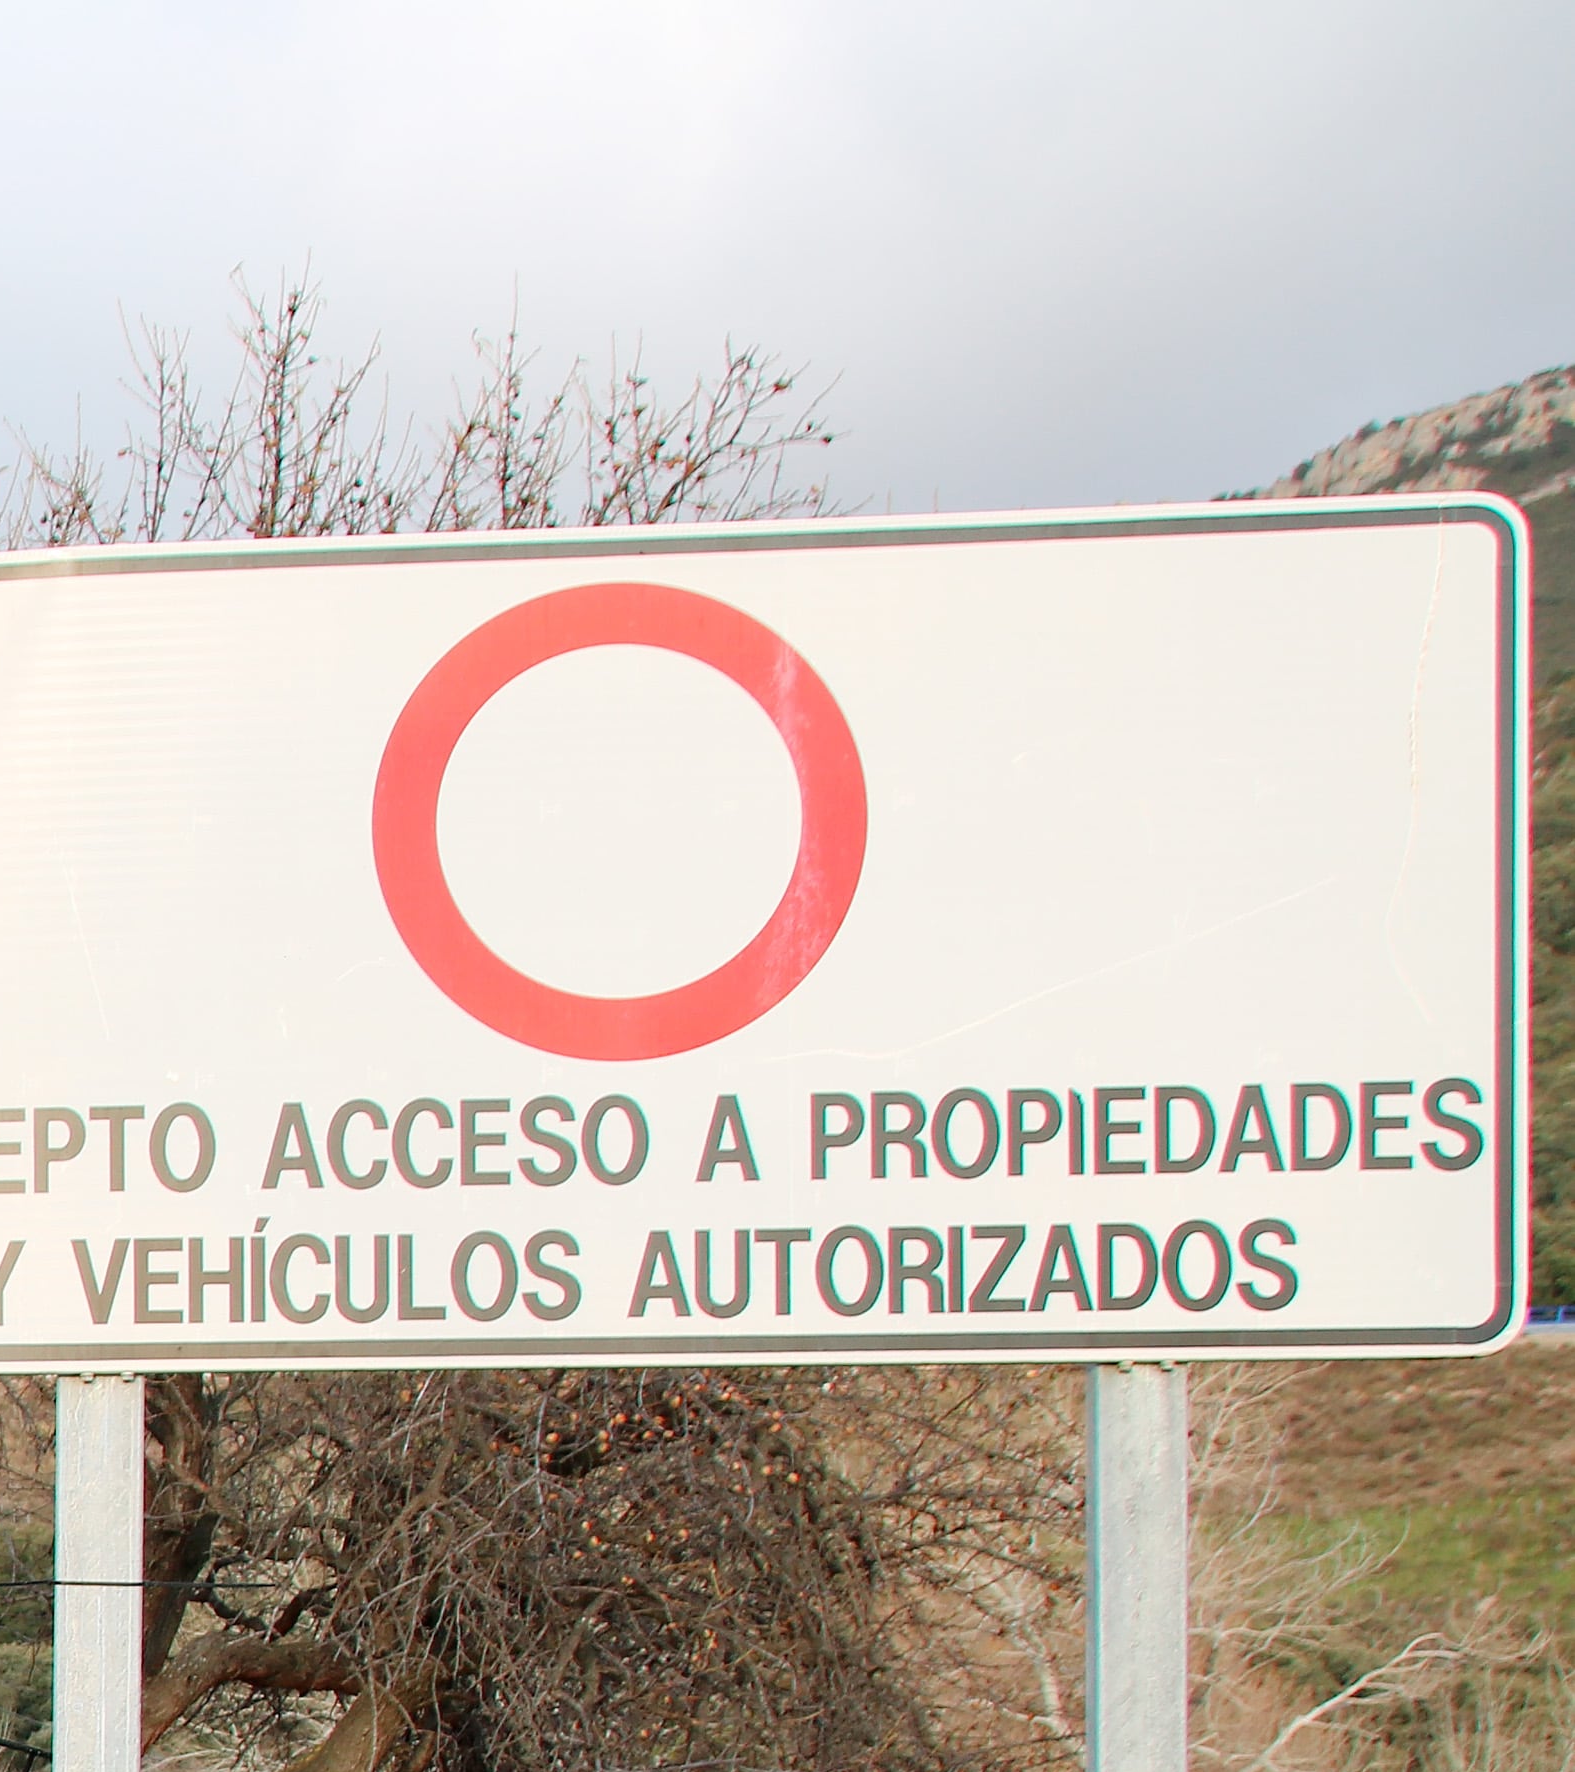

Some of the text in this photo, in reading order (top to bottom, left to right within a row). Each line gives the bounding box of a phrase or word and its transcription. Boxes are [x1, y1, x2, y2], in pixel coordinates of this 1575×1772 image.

[261, 1094, 649, 1191] ACCESO
[695, 1094, 760, 1184] A
[809, 1077, 1485, 1183] PROPIEDADES
[71, 1216, 582, 1326] VEHÍCULOS
[627, 1219, 1299, 1319] AUTORIZADOS
